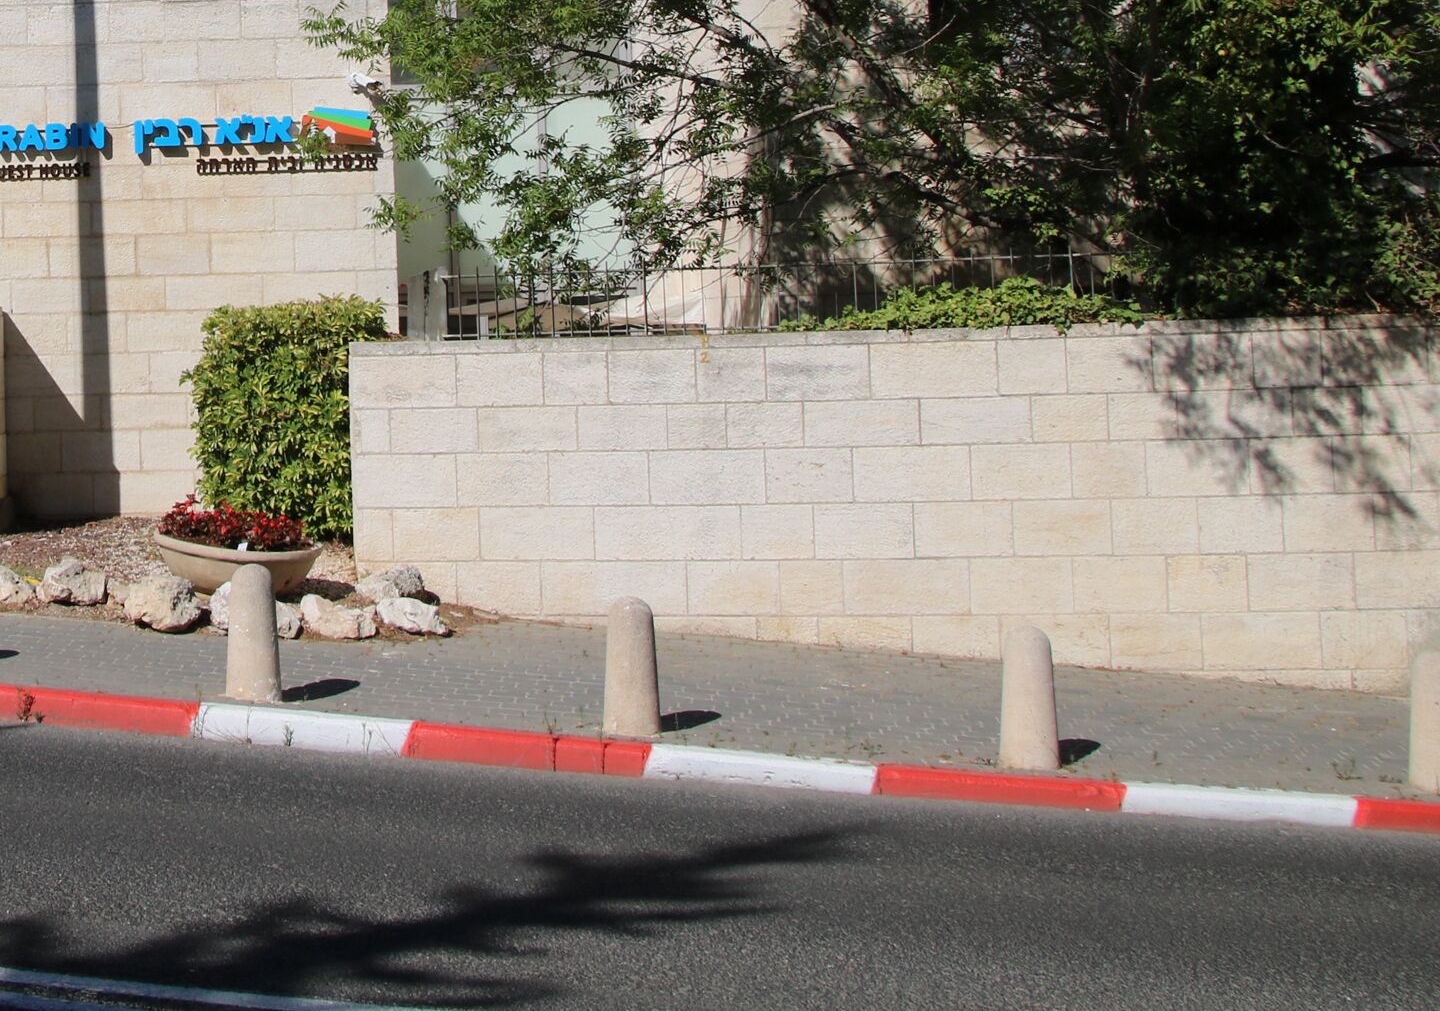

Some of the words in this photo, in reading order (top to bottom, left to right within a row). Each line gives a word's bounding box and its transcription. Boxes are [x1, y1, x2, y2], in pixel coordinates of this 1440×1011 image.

[134, 117, 203, 155] רבין
[40, 163, 91, 179] HOUSE
[196, 157, 257, 174] הארחה
